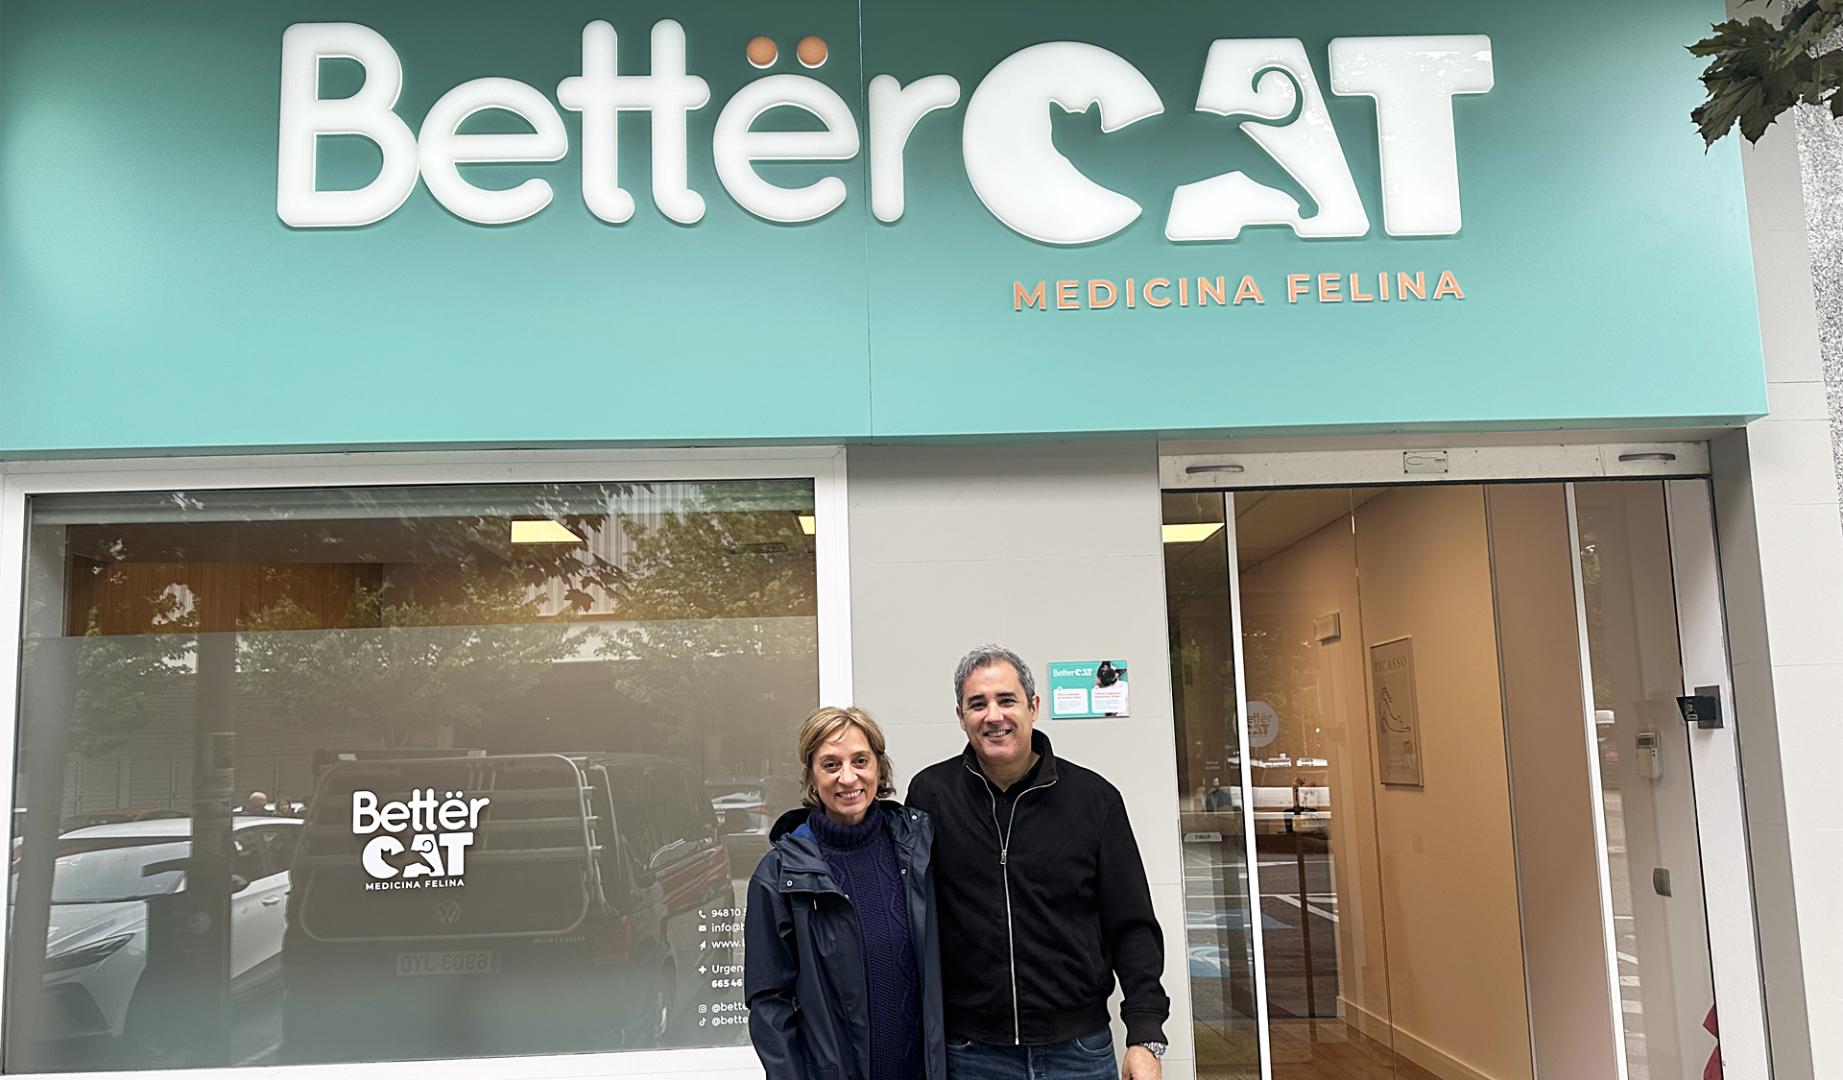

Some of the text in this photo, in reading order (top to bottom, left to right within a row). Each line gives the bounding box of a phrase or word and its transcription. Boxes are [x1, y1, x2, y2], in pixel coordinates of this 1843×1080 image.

[1012, 270, 1465, 312] MEDICINA FELINA
[352, 788, 490, 834] Bettër
[362, 831, 474, 879] CAT
[365, 879, 465, 891] MEDICINA FELINA
[711, 909, 729, 918] 948
[730, 908, 741, 917] 10
[711, 978, 743, 988] 665 46
